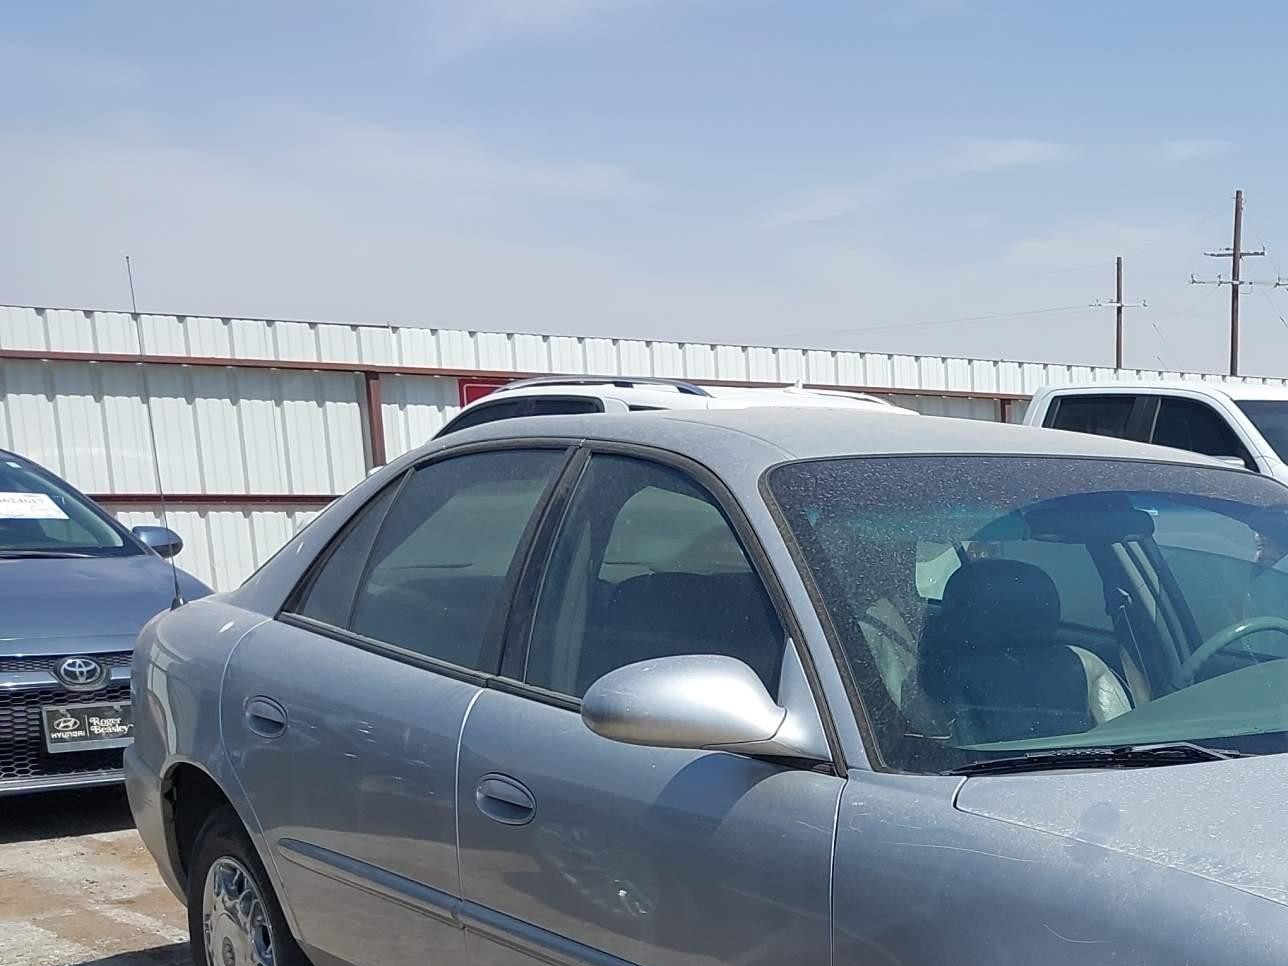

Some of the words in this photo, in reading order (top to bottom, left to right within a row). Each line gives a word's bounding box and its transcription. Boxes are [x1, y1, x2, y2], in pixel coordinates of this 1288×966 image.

[89, 717, 122, 726] Roger
[90, 724, 129, 734] Beasley
[51, 730, 86, 739] HYUNDAI
